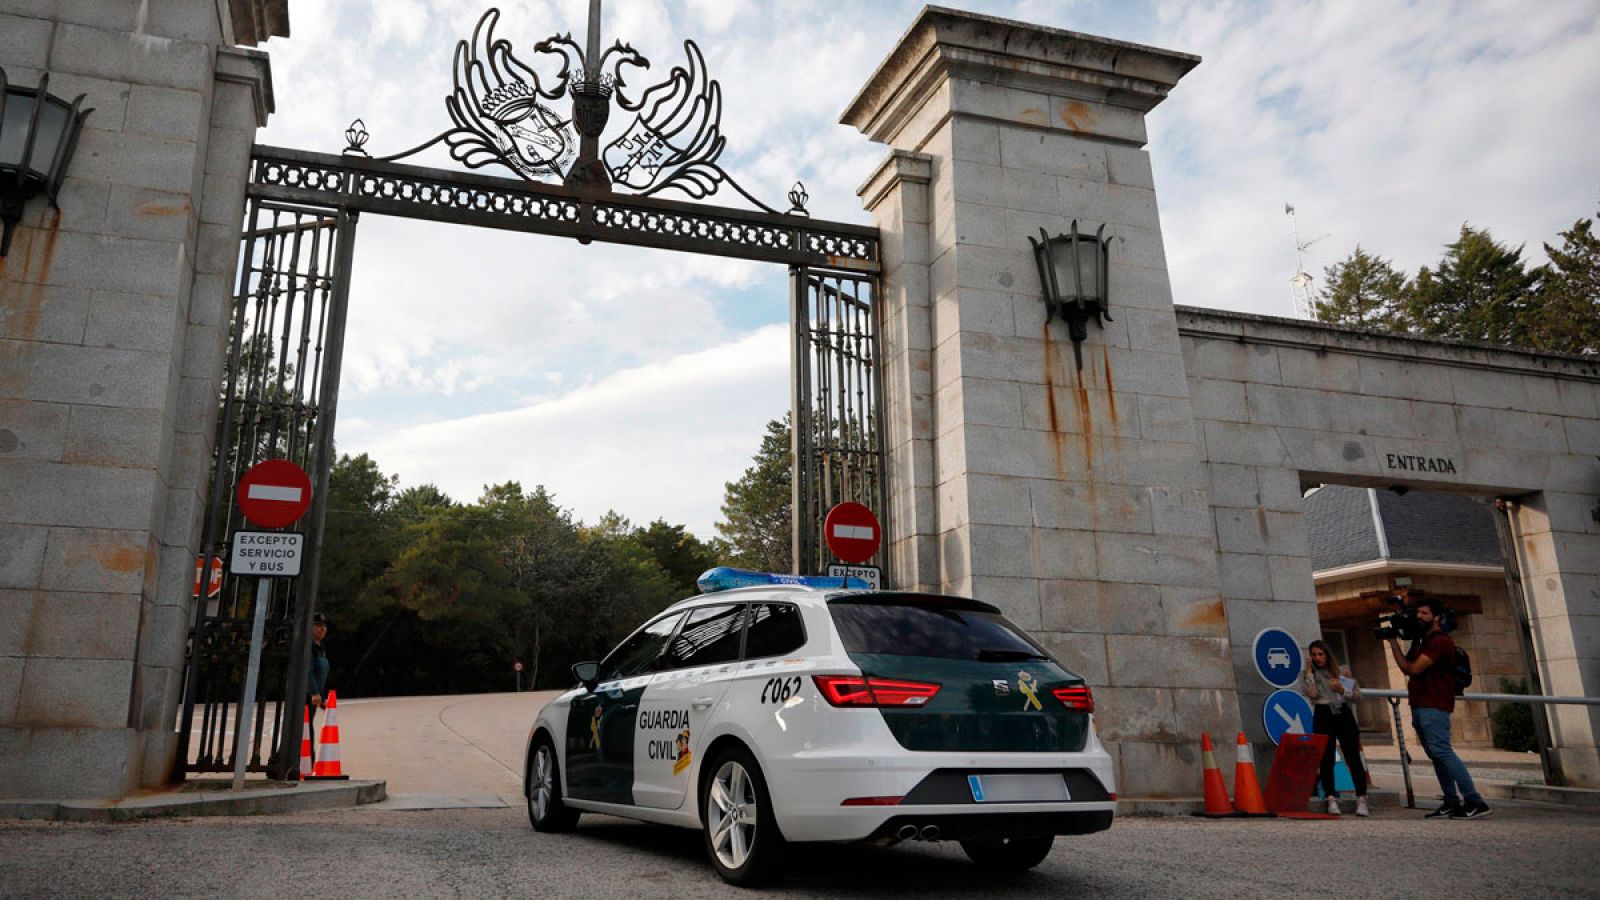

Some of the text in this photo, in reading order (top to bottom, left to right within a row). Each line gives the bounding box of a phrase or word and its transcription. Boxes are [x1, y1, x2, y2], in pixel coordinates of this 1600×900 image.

[1386, 454, 1457, 474] ENTRADA
[239, 535, 298, 546] EXCEPTO
[239, 548, 296, 559] SERVICIO
[248, 561, 285, 572] Y BUS
[639, 709, 690, 729] GUARDIA
[648, 739, 677, 761] CIVIL
